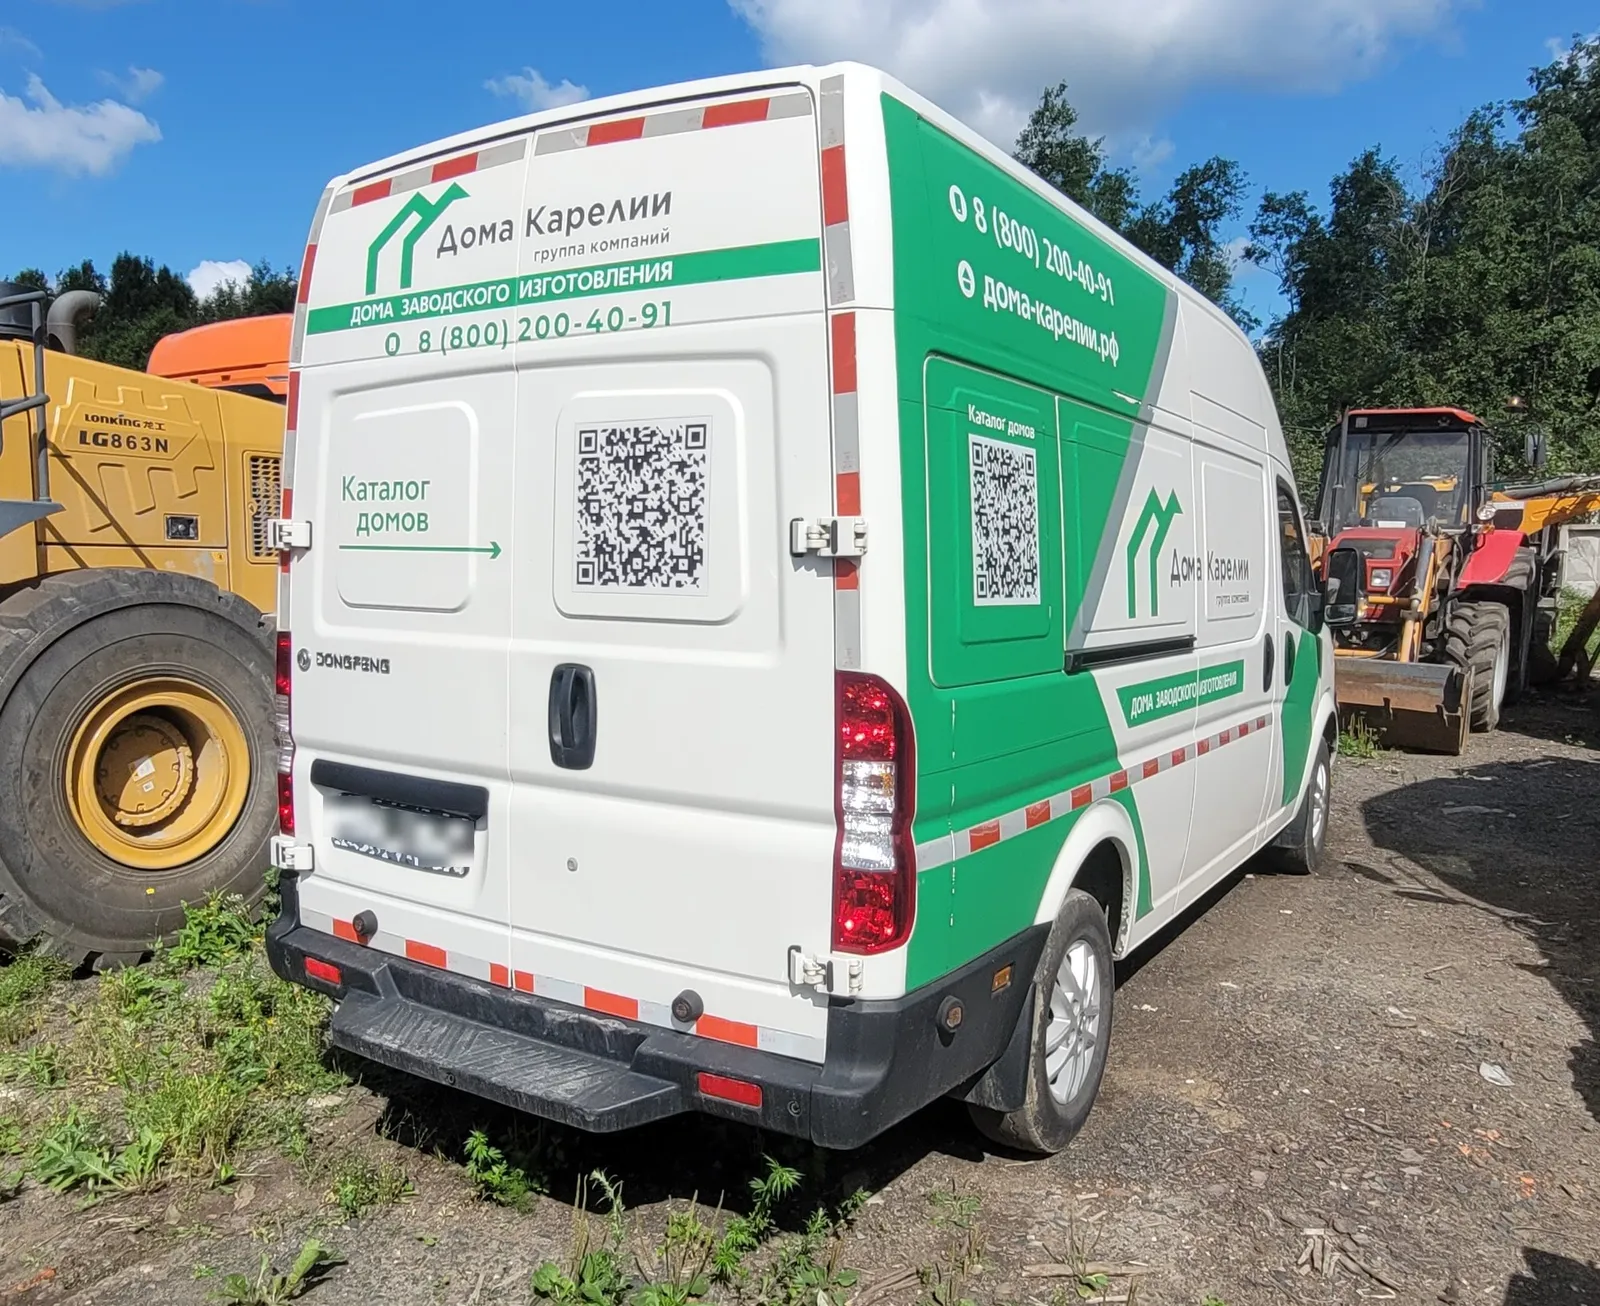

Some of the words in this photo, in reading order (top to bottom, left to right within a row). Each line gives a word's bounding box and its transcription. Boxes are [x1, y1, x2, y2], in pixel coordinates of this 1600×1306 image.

[436, 218, 514, 259] Дома
[525, 191, 672, 238] Карелии
[534, 243, 585, 264] группа
[590, 227, 671, 253] компаний
[973, 197, 987, 233] 8
[992, 206, 1040, 268] (800)
[1042, 238, 1115, 306] 200-40-91
[350, 301, 395, 327] ДОМА
[401, 283, 510, 316] ЗАВОДСКОГО
[519, 260, 674, 299] ИЗГОТОВЛЕНИЯ
[418, 329, 432, 353] 8
[441, 319, 508, 355] (800)
[518, 300, 672, 341] 200-40-91
[983, 274, 1120, 367] дома-карелии.рф
[968, 404, 1007, 431] Каталог
[1007, 421, 1036, 440] домов
[79, 430, 169, 453] LG863N
[341, 475, 431, 501] Каталог
[356, 511, 429, 537] домов
[1170, 548, 1203, 588] Дома
[1207, 550, 1249, 588] Карелии
[315, 652, 391, 675] DONGFENG
[1130, 693, 1154, 720] ДОМА
[1155, 682, 1198, 709] ЗАВОДСКОГО
